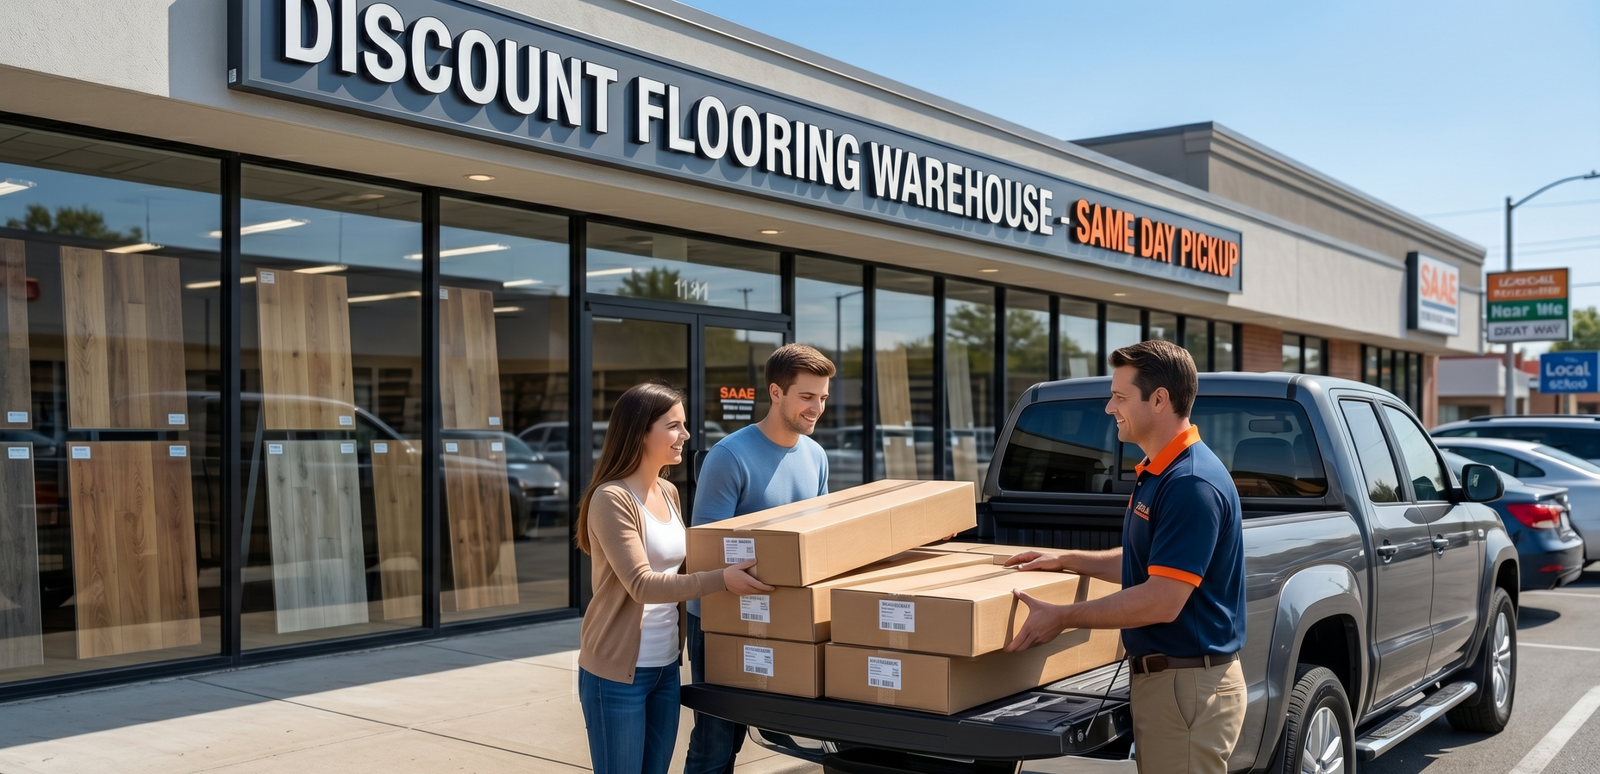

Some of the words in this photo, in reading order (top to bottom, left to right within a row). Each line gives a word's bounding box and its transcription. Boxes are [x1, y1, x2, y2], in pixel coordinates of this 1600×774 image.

[283, 0, 618, 134] DISCOUNT
[634, 76, 861, 191] FLOORING
[869, 141, 1054, 235] WAREHOUSE
[1072, 199, 1136, 255] SAME
[1140, 217, 1177, 262] DAY
[1179, 228, 1240, 278] PICKUP
[1421, 263, 1457, 306] SAAE
[1546, 360, 1591, 377] Local
[720, 386, 755, 400] SAAE
